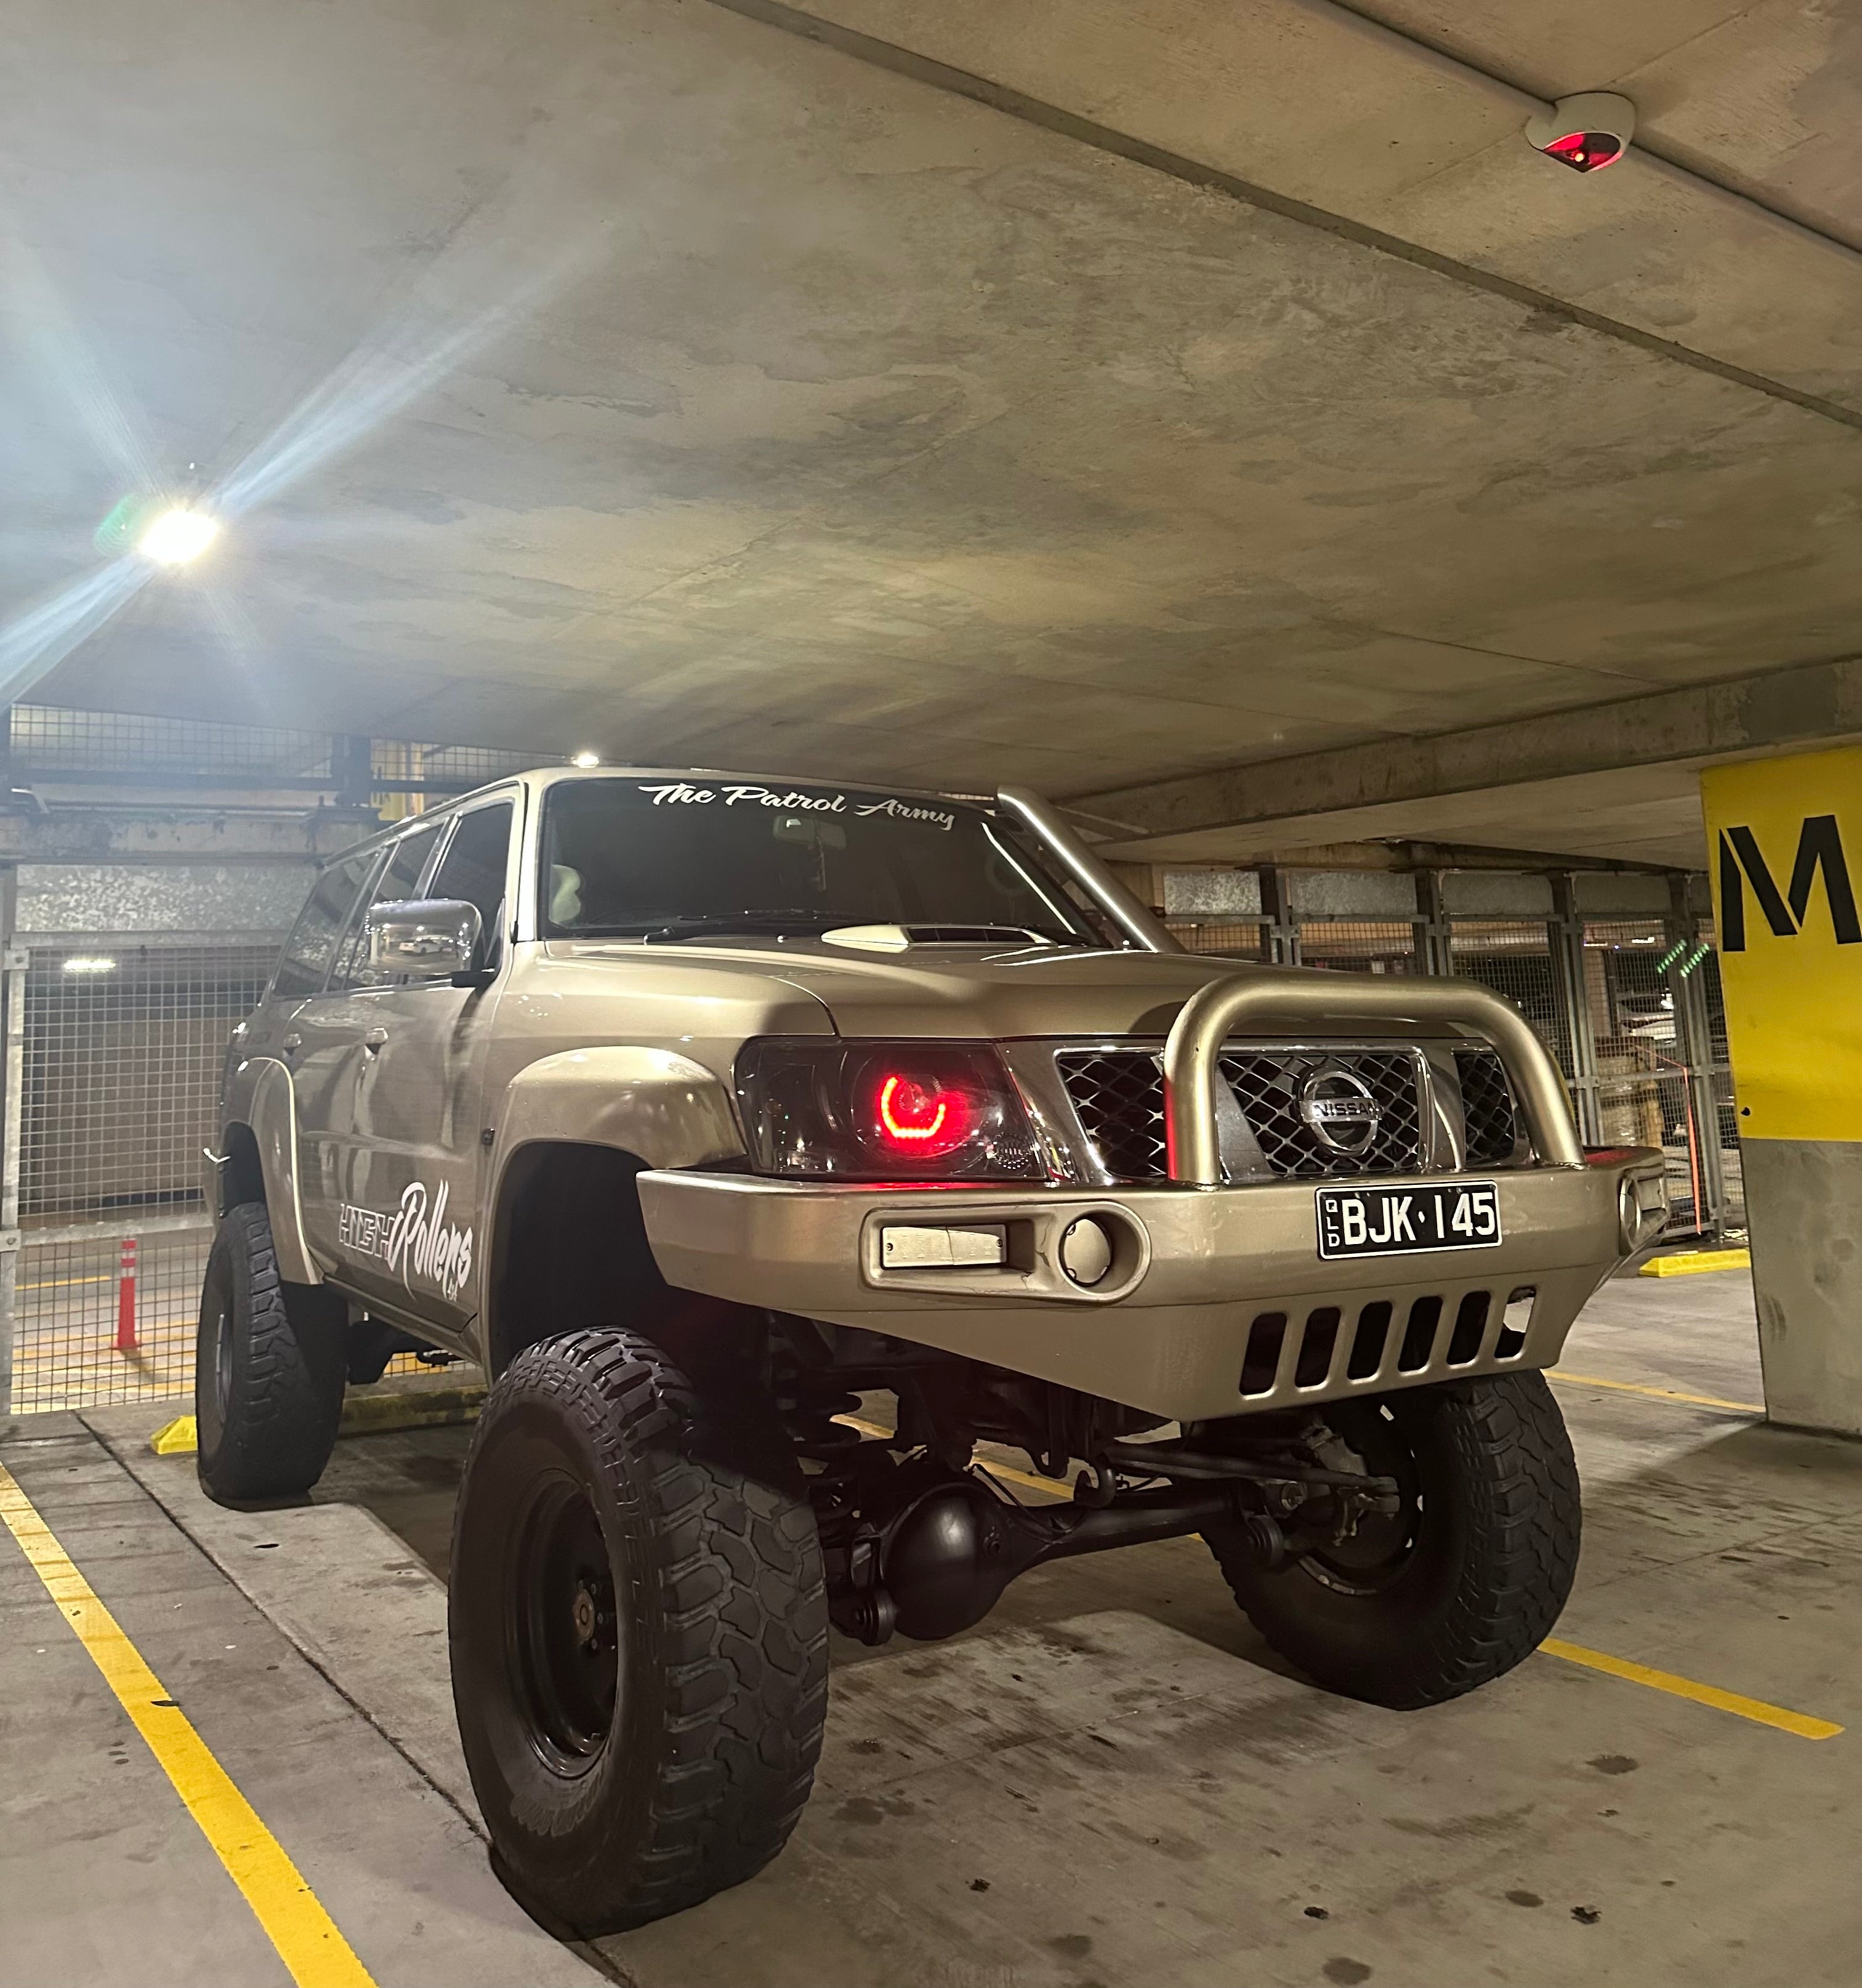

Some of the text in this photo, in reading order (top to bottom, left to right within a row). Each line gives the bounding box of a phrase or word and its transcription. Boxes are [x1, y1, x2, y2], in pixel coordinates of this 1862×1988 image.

[638, 783, 954, 830] The Patrol Army
[1719, 814, 1862, 952] M
[1313, 1102, 1378, 1117] NISSAN
[1325, 1200, 1340, 1247] QLD
